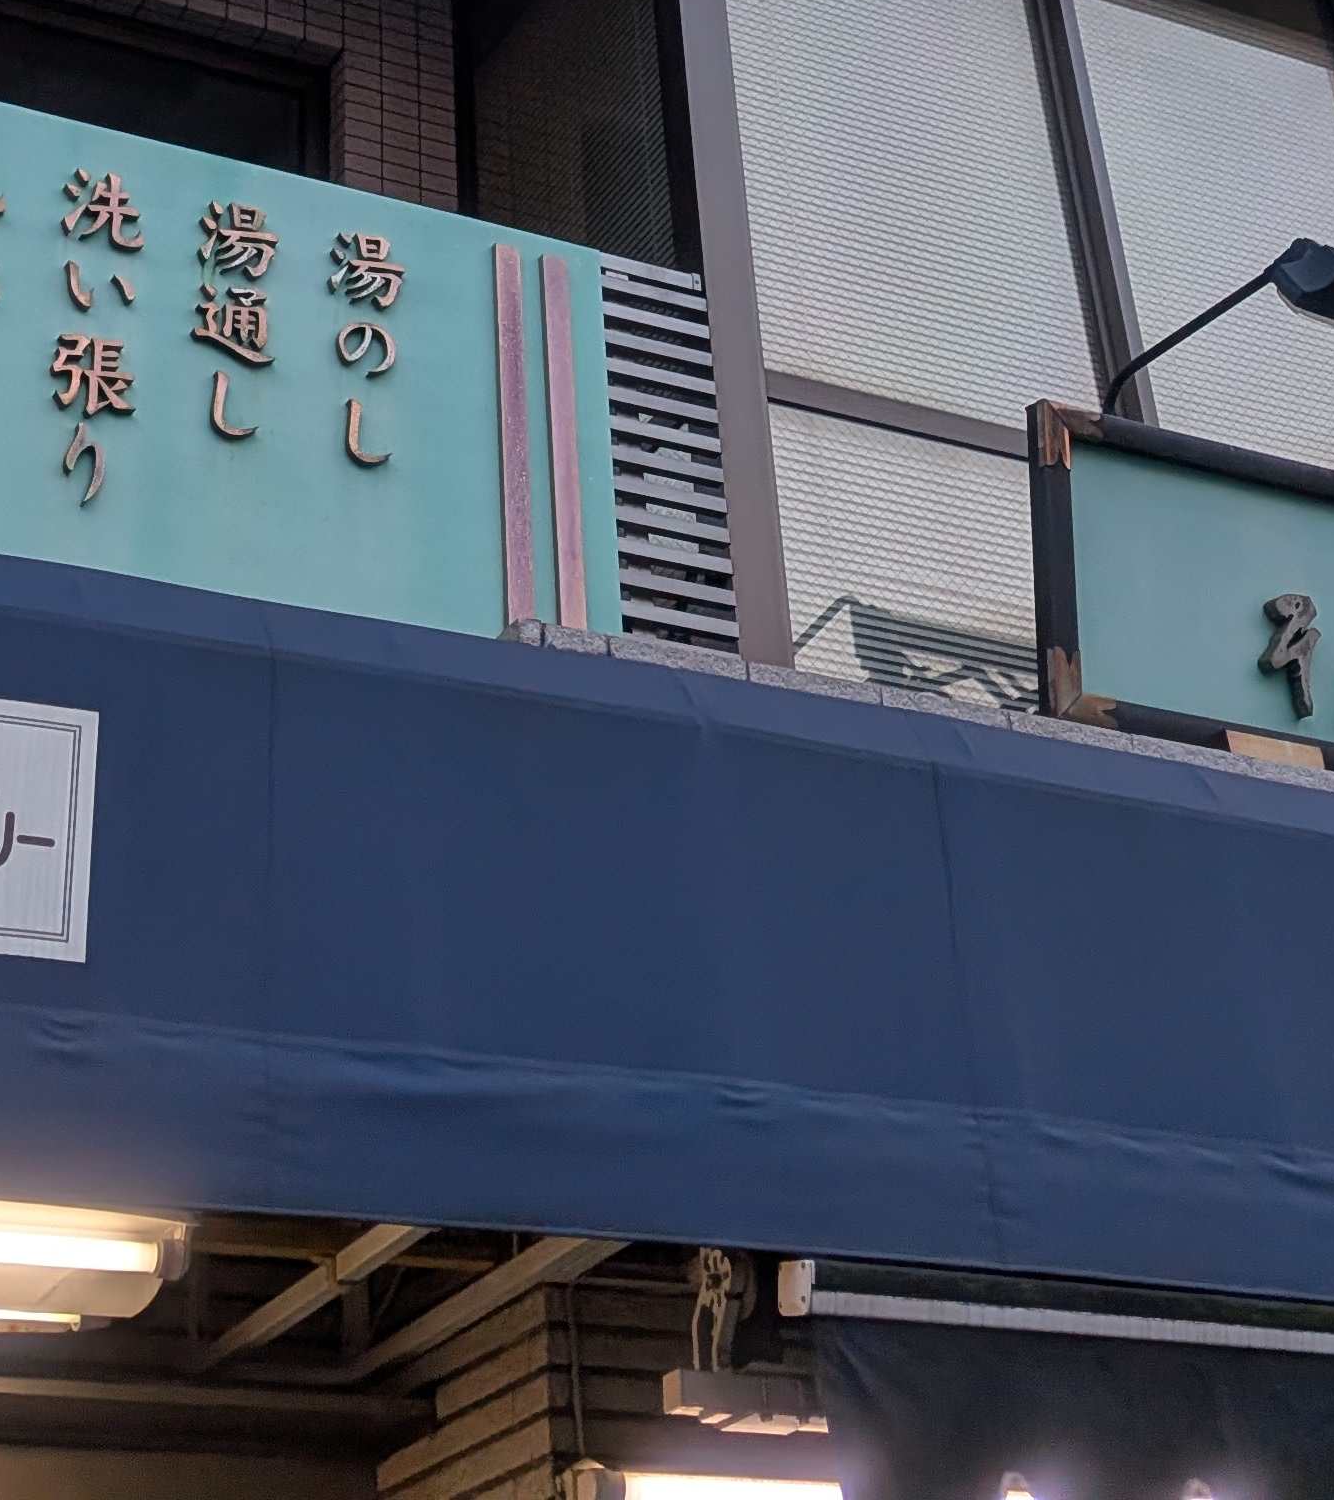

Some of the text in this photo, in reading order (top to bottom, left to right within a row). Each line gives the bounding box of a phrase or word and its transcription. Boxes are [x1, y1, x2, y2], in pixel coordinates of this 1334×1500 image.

[51, 168, 145, 508] 洗い張り
[191, 201, 279, 441] 湯通し
[327, 231, 406, 468] 湯のし
